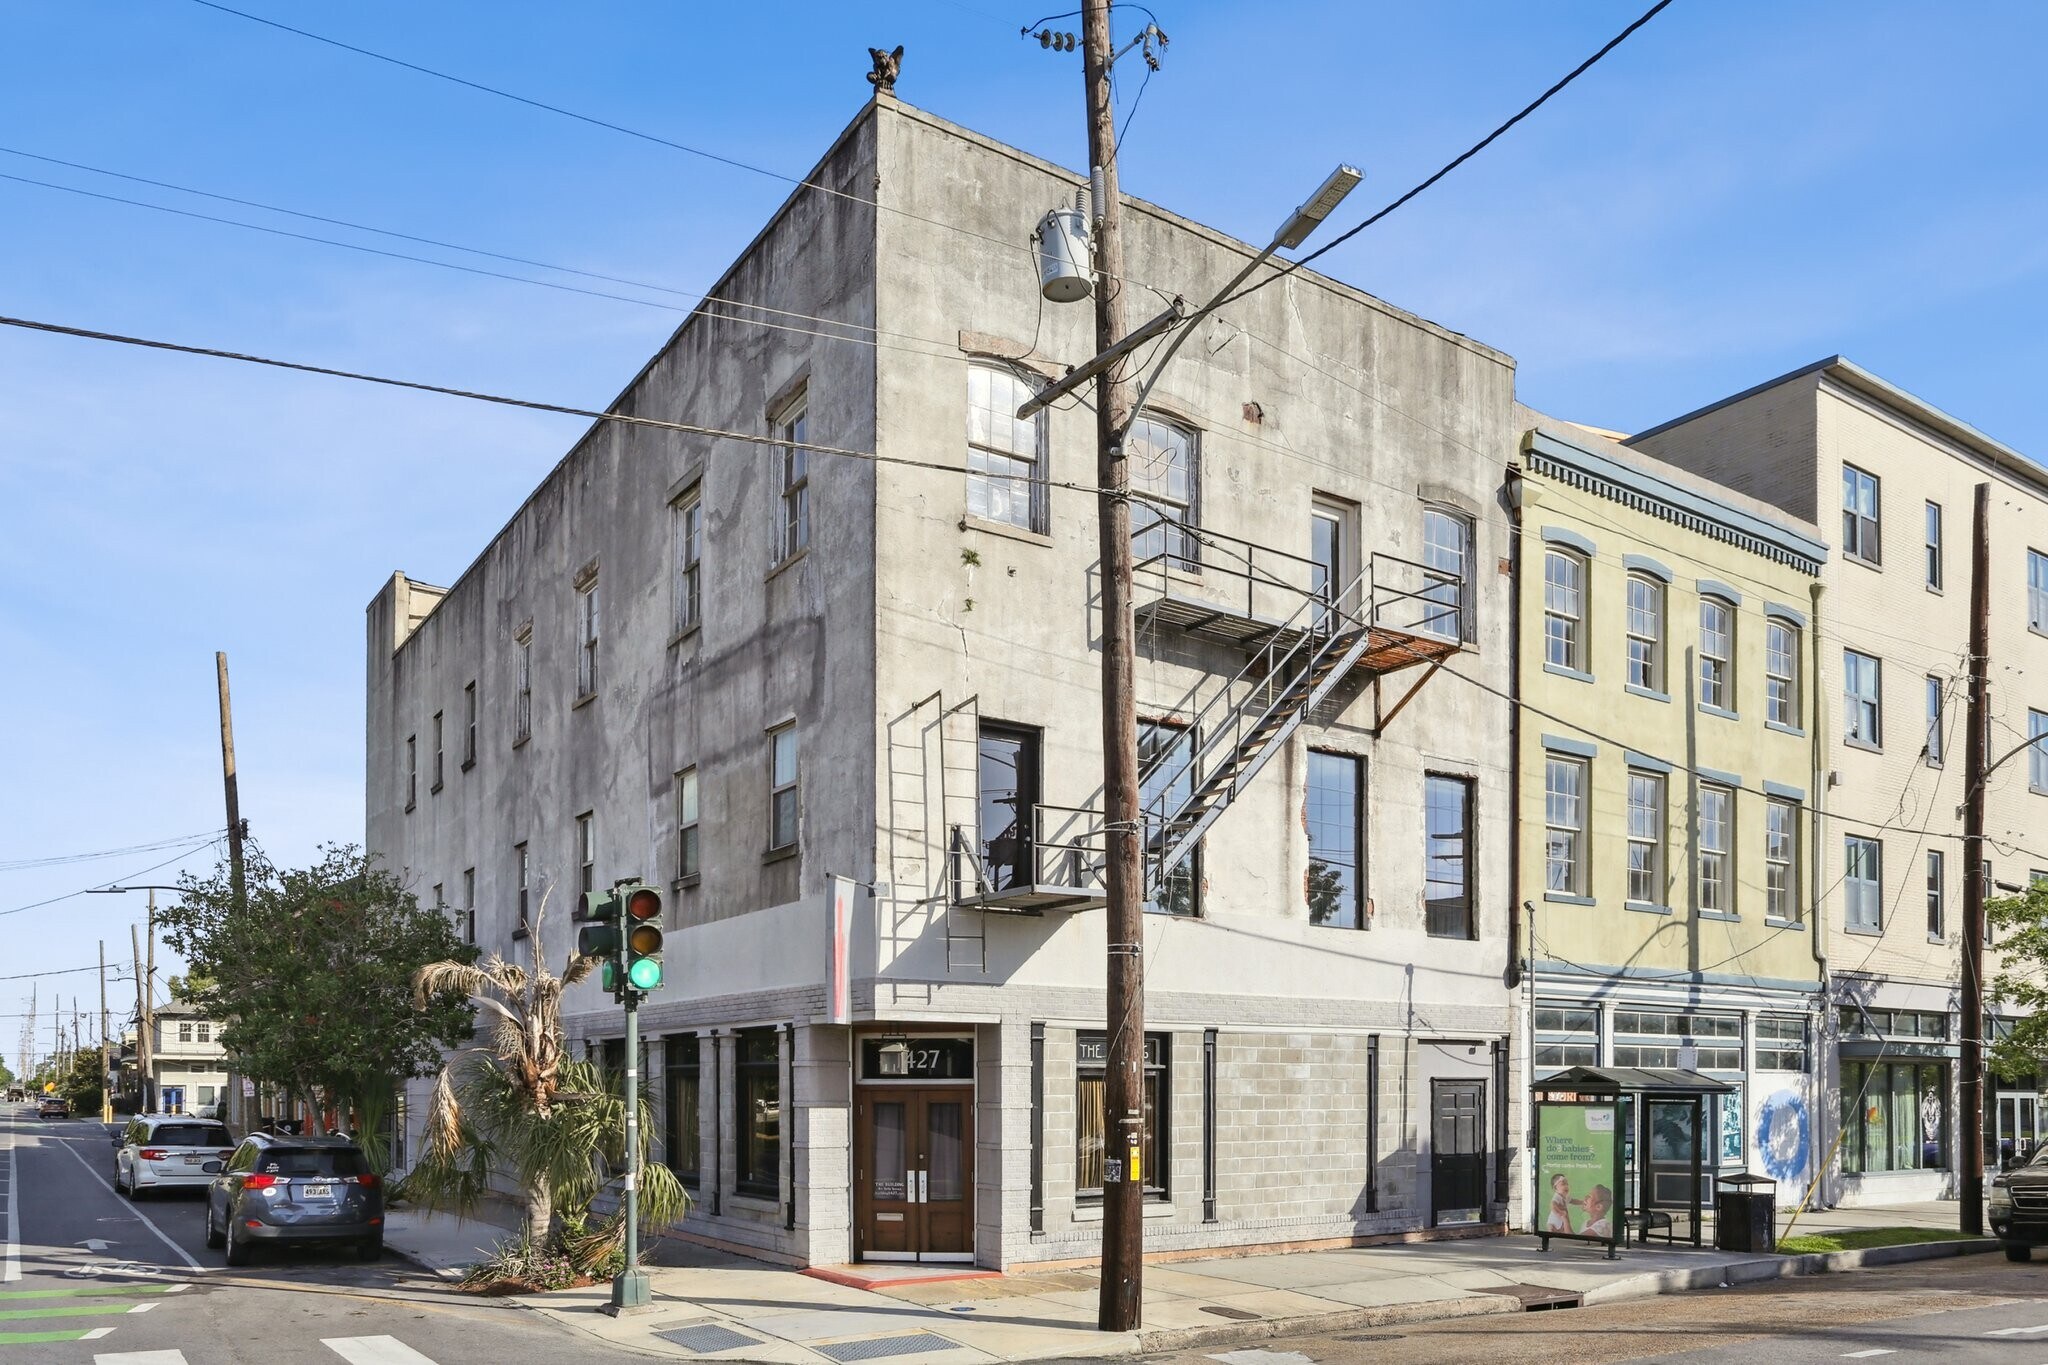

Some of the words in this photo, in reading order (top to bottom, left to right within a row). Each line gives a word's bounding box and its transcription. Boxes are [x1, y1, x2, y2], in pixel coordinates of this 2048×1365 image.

[1079, 1044, 1102, 1058] THE
[1545, 1136, 1573, 1144] Where
[1546, 1144, 1557, 1152] do
[1562, 1144, 1589, 1152] babies
[1570, 1153, 1595, 1161] from?
